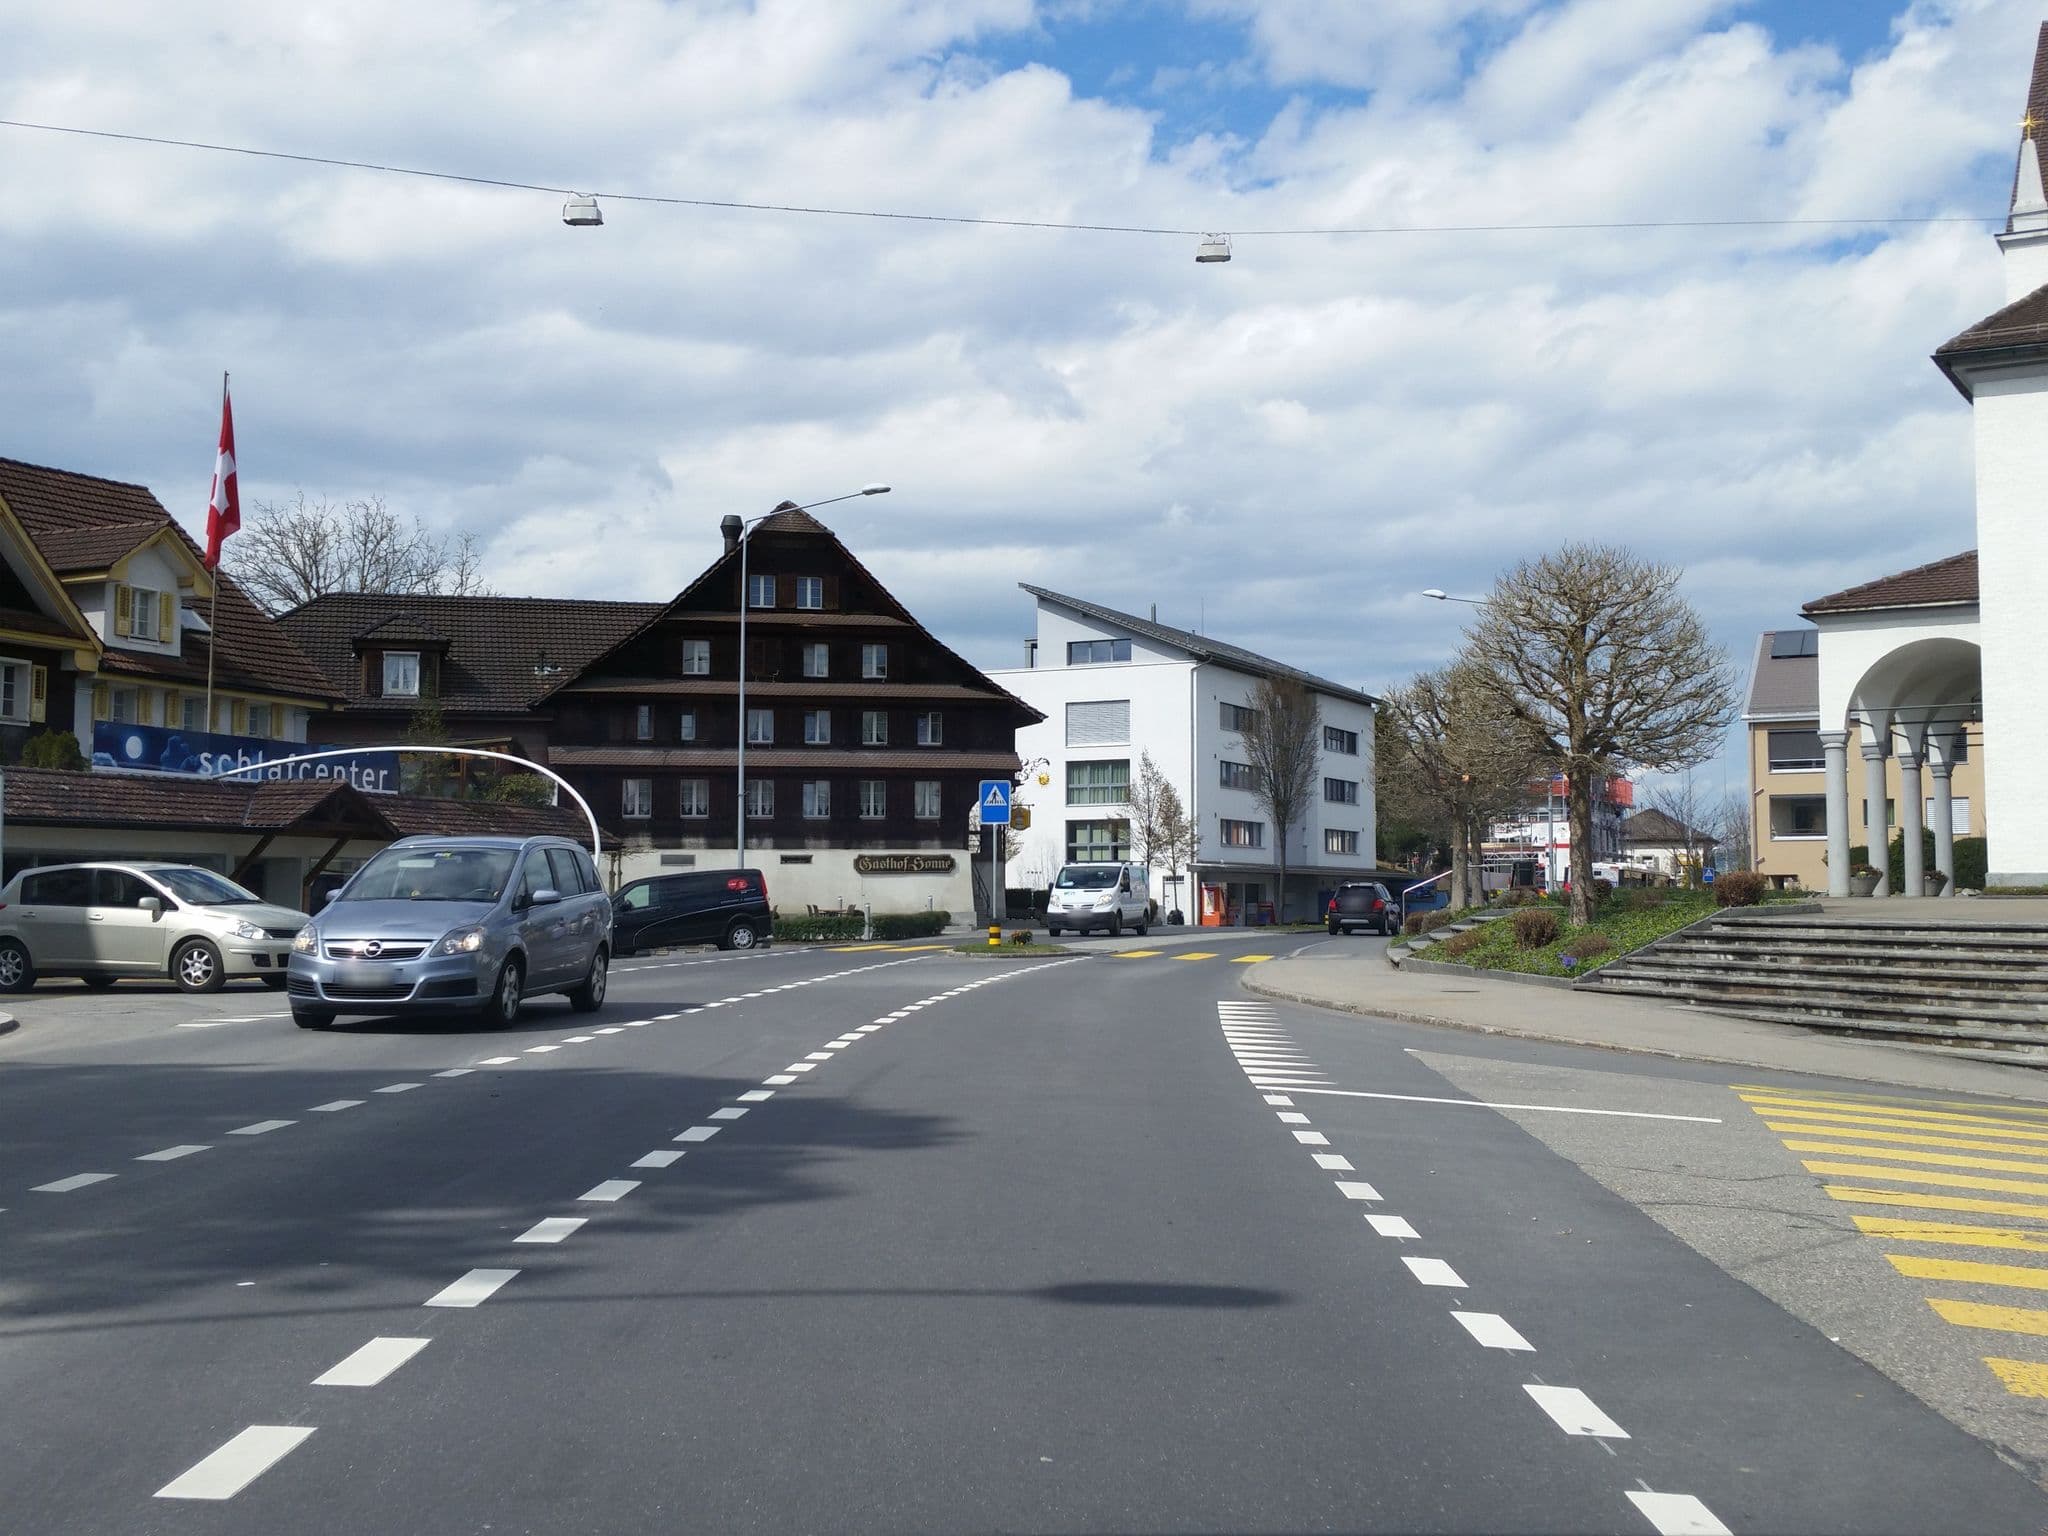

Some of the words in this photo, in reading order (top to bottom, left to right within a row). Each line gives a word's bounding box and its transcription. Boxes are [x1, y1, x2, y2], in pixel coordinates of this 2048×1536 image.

[199, 748, 389, 790] schlafcenter
[859, 856, 909, 873] Gasthof
[909, 856, 951, 872] Sonne
